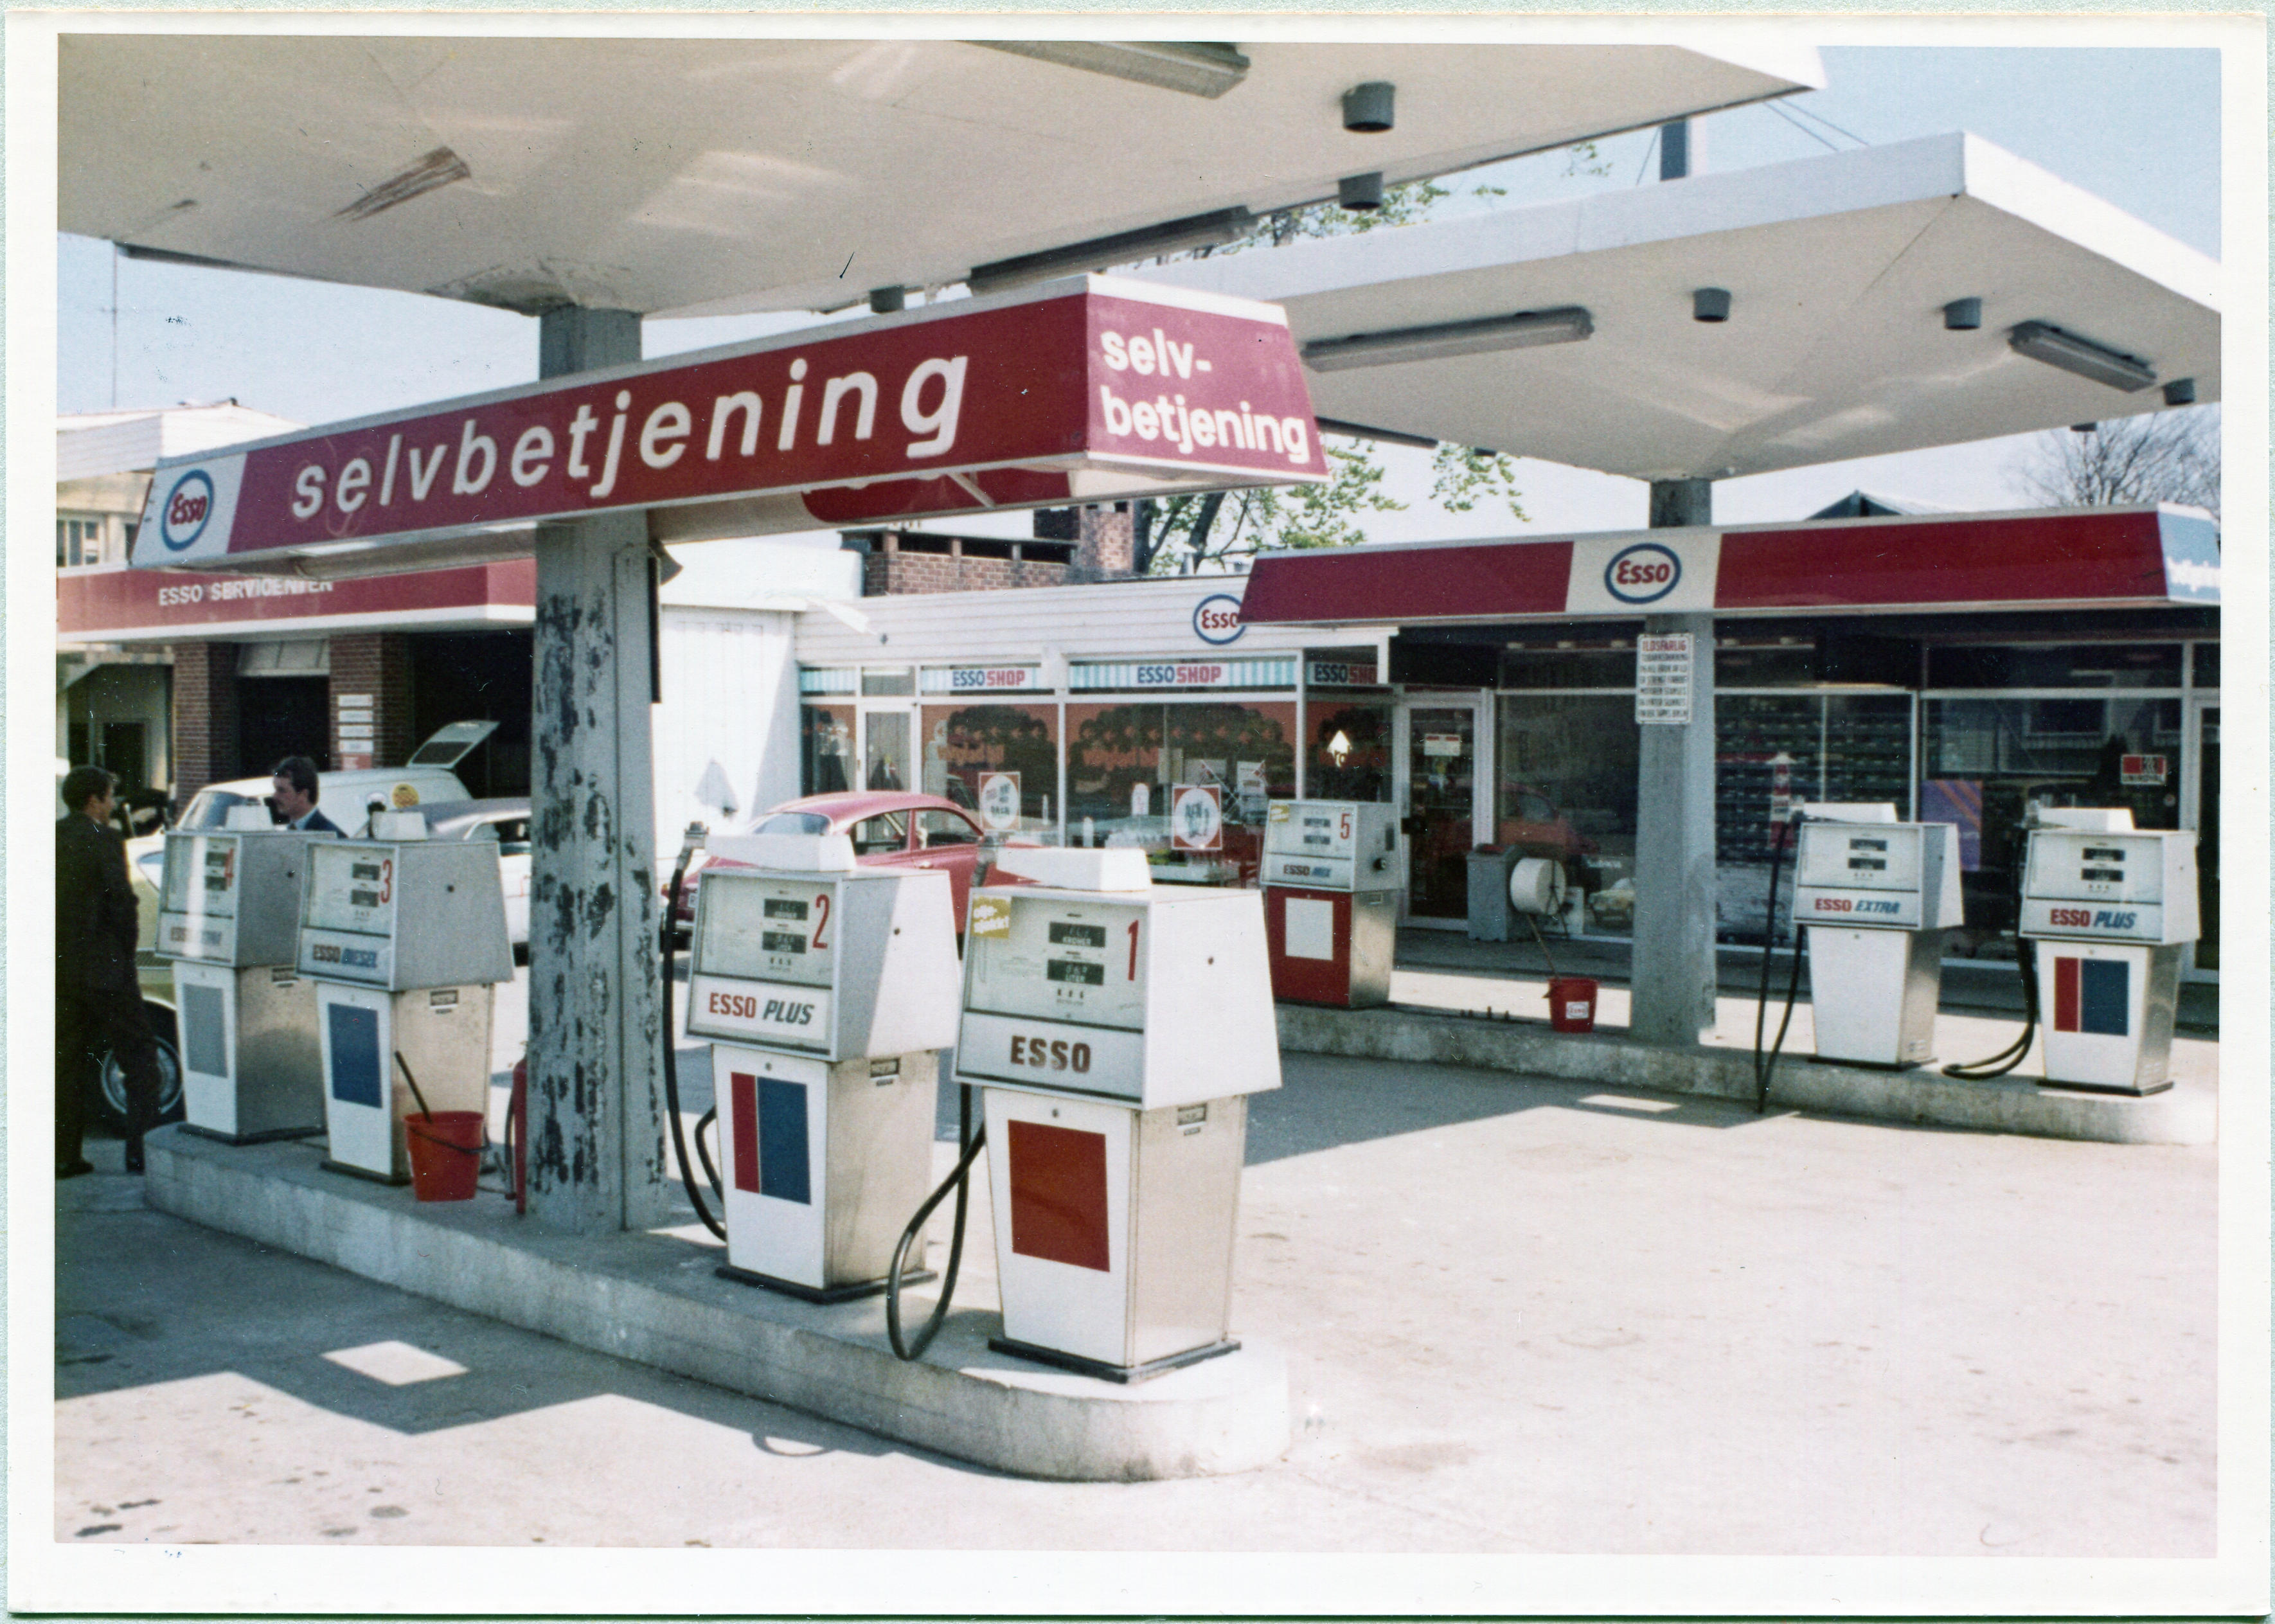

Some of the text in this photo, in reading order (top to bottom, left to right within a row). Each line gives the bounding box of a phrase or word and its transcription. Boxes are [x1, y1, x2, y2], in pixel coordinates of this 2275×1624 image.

[1100, 327, 1212, 379] selv-
[292, 355, 968, 519] selvbetjening
[1100, 384, 1310, 465] betjening
[1616, 559, 1670, 585] Esso
[159, 584, 203, 606] ESSO
[1350, 664, 1377, 684] SHO
[1340, 813, 1350, 840] 5
[380, 859, 393, 904] 3
[1284, 864, 1310, 877] ESSO
[812, 894, 830, 949] 2
[1815, 898, 1900, 914] ESSO EXTRA
[2050, 909, 2137, 929] ESSO PLUS
[1127, 919, 1139, 981] 1
[709, 992, 816, 1026] ESSO PLUS
[1010, 1035, 1091, 1074] ESSO
